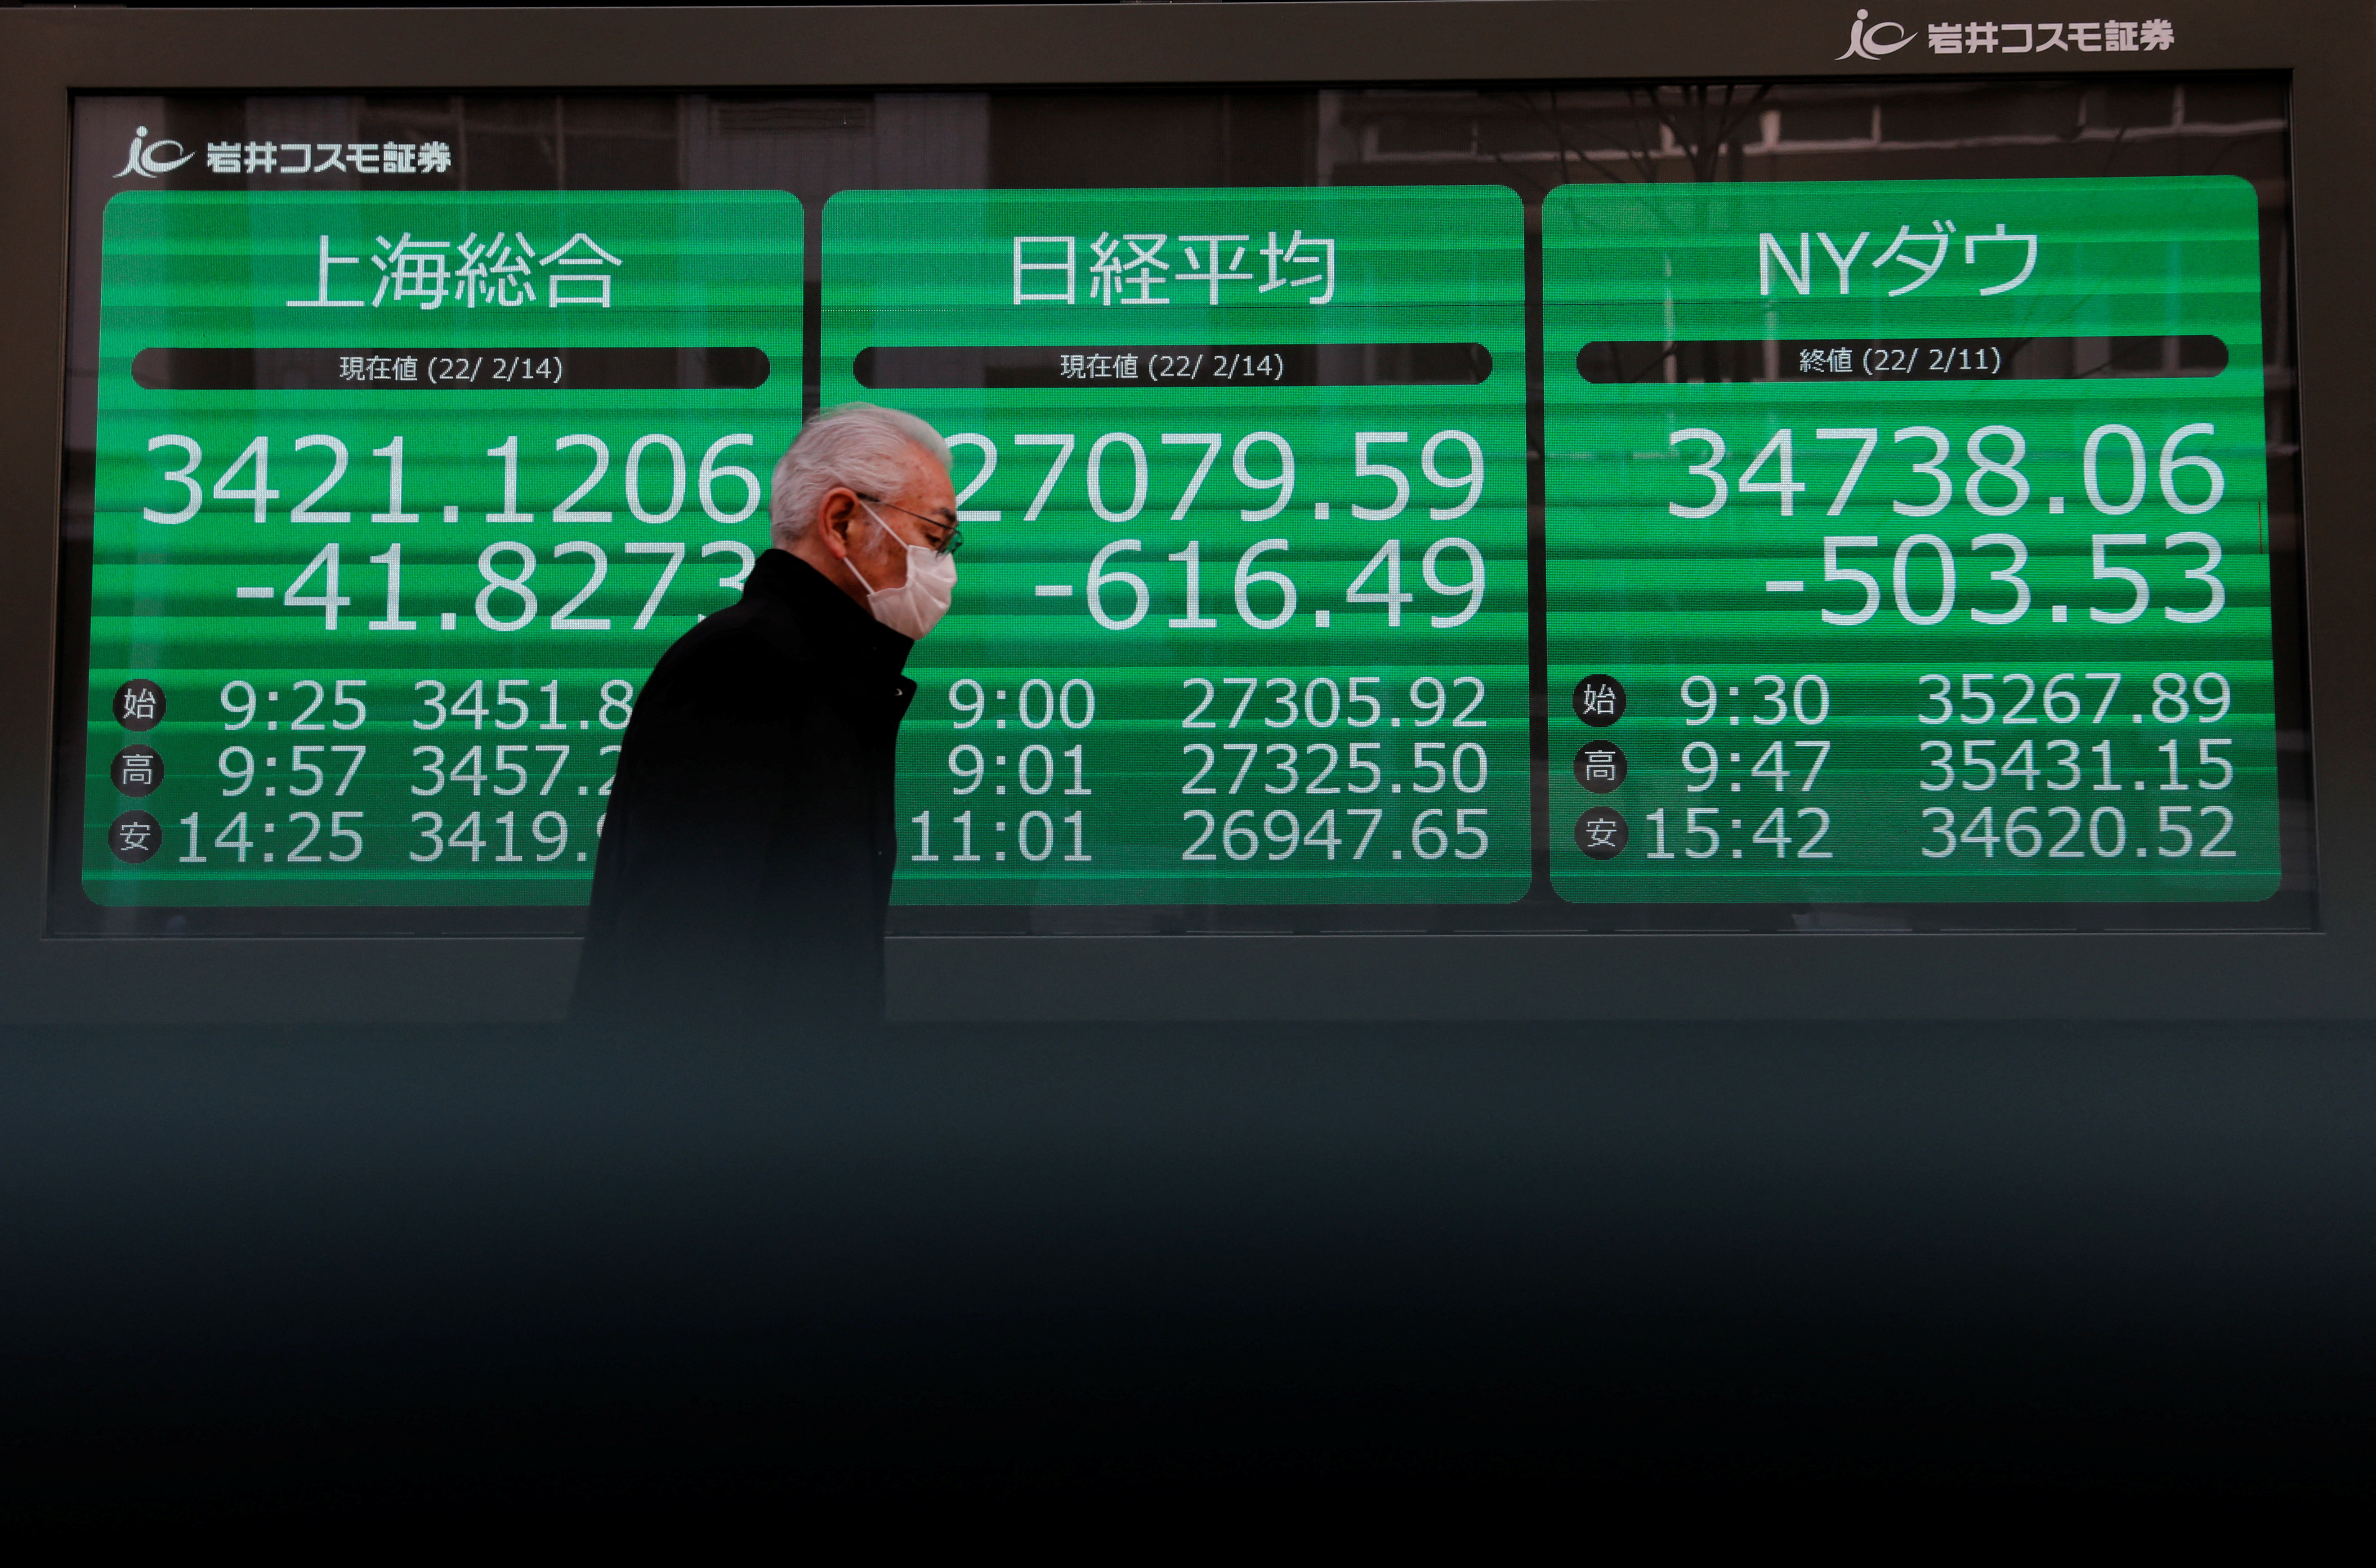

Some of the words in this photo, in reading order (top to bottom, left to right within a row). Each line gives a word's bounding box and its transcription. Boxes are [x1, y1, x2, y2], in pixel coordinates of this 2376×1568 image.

[1928, 19, 2174, 54] 岩井コスモ証券
[207, 141, 451, 173] 岩井コスモ証券
[286, 232, 622, 310] 上海総合
[1013, 230, 1335, 306] 日経平均
[1759, 220, 2037, 297] NYダウ
[340, 356, 417, 381] 現在値
[1061, 353, 1138, 378] 現在値
[1800, 347, 1852, 372] 終値
[143, 433, 761, 524] 3421.1206
[944, 430, 1484, 523] 27079.59
[1669, 423, 2224, 518] 34738.06
[1035, 537, 1485, 630] -616.49
[1766, 532, 2224, 625] -503.53
[123, 688, 156, 719] 始
[220, 680, 366, 730] 9:25
[949, 679, 1094, 729] 9:00
[1182, 676, 1487, 728] 27305.92
[1583, 684, 1616, 715] 始
[1681, 675, 1829, 726] 9:30
[1918, 672, 2230, 724] 35267.89
[123, 754, 153, 785] 高
[219, 745, 366, 796] 9:57
[948, 744, 1091, 795] 9:01
[1182, 742, 1487, 794] 27325.50
[1585, 750, 1615, 781] 高
[1682, 741, 1831, 792] 9:47
[1920, 738, 2232, 791] 35431.15
[120, 822, 151, 851] 安
[179, 811, 363, 862] 14:25
[411, 811, 607, 862] 3419.
[912, 810, 1092, 861] 11:01
[1182, 809, 1488, 860] 26947.65
[1586, 818, 1616, 847] 安
[1646, 807, 1832, 858] 15:42
[1922, 805, 2236, 858] 34620.52
